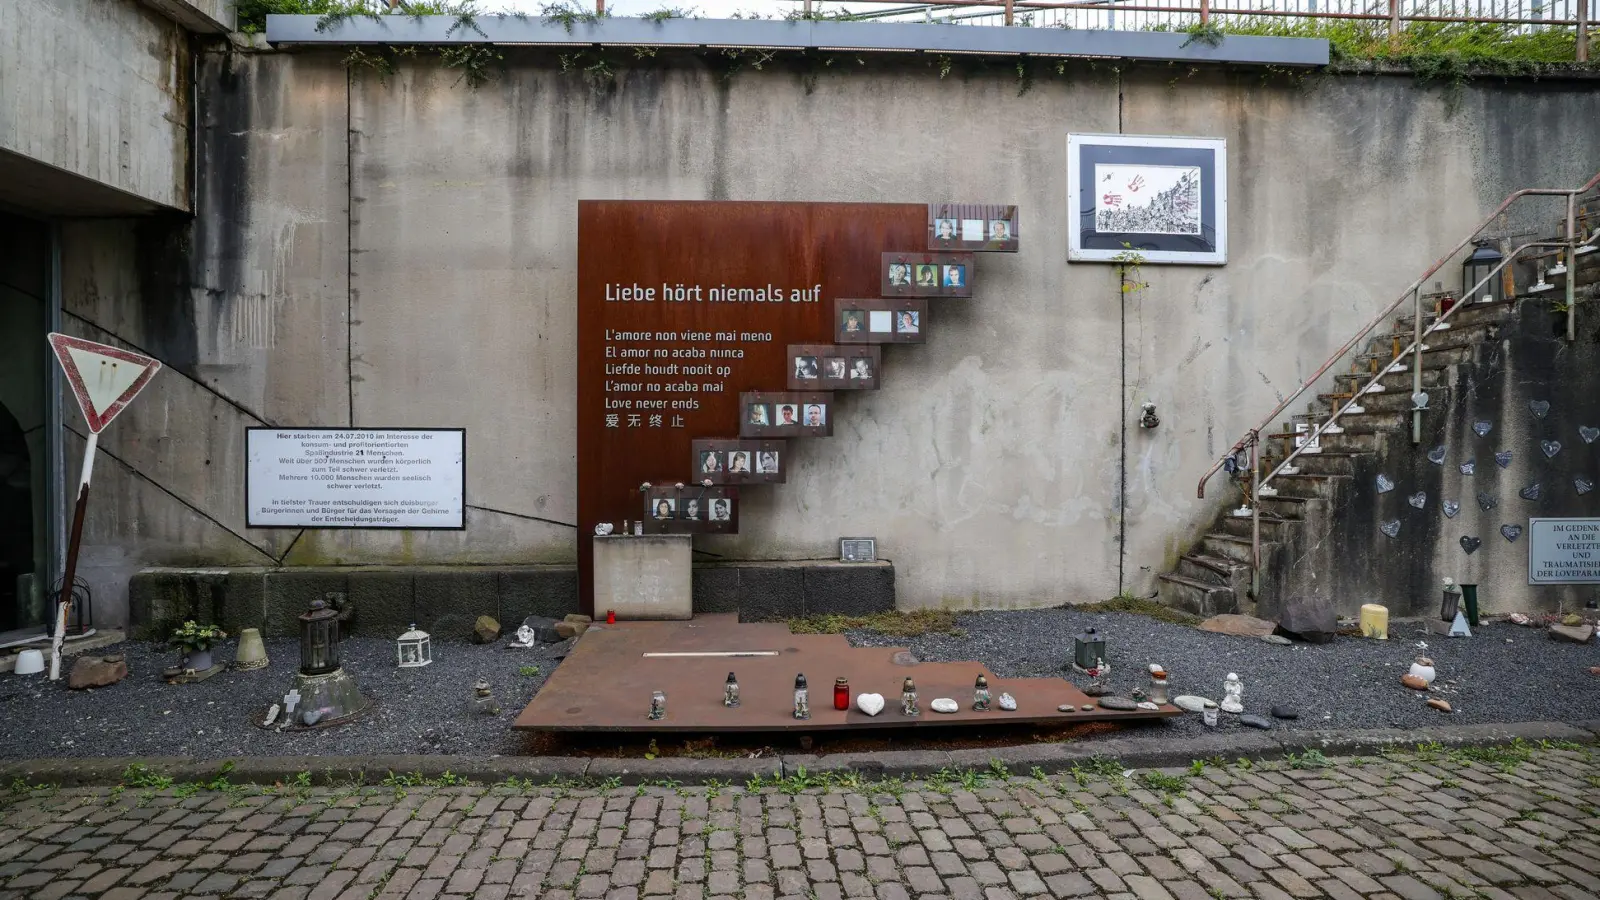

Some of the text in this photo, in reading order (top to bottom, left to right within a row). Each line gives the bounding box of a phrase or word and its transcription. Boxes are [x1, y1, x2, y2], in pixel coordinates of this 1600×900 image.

[605, 283, 821, 302] Liebe hört niemals auf
[605, 329, 772, 341] L'amore non viene mai meno
[605, 347, 744, 358] El amor no acaba nunca
[605, 364, 731, 377] Liefde houdt nooit op
[647, 382, 660, 392] no
[665, 381, 698, 392] acaba
[703, 381, 724, 392] mai
[605, 398, 699, 409] Love never ends
